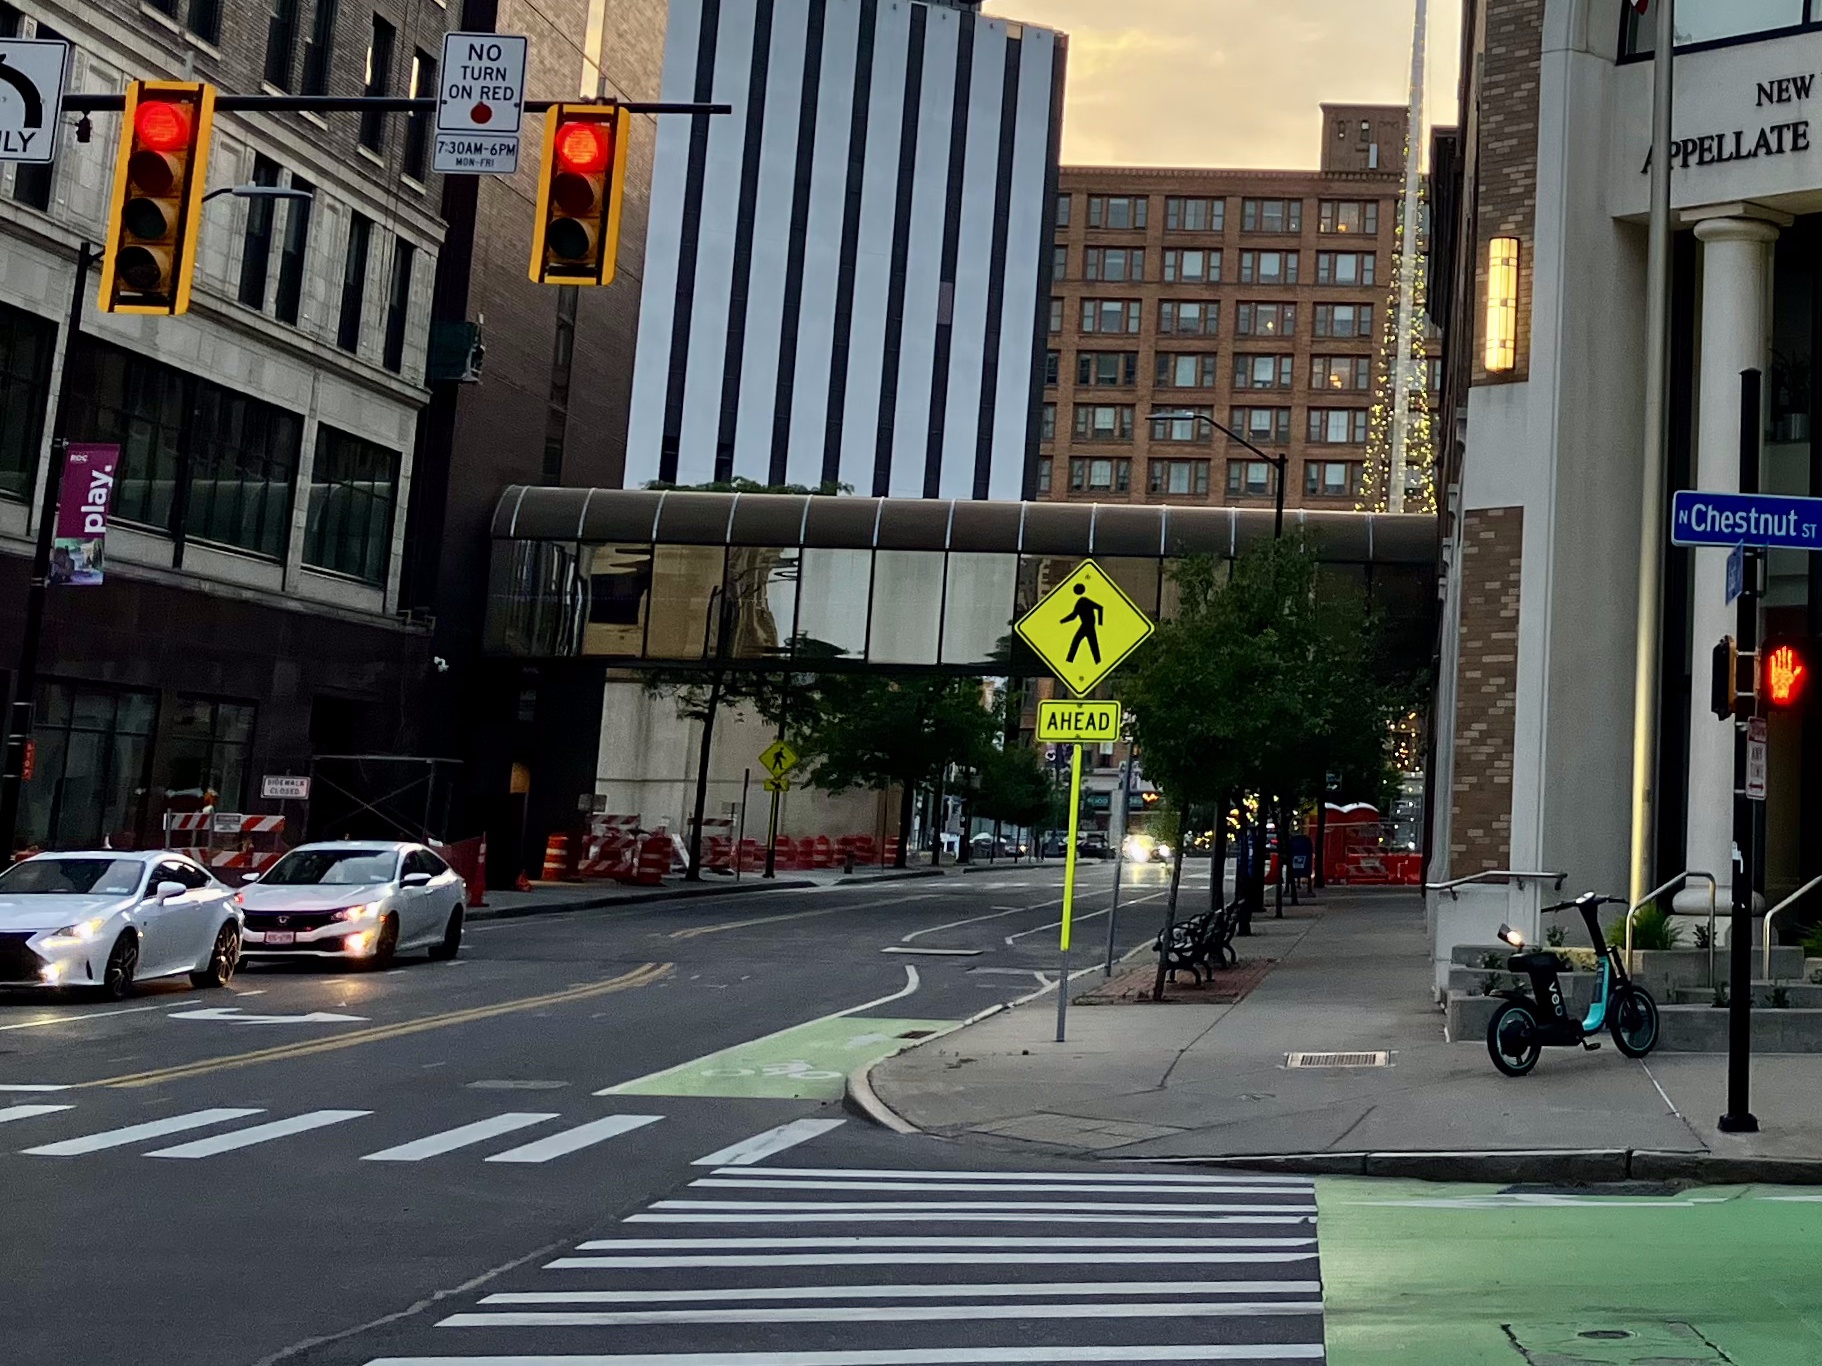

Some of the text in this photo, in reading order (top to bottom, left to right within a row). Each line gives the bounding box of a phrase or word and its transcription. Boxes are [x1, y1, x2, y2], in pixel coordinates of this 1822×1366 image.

[468, 43, 502, 62] NO
[460, 65, 507, 82] TURN
[449, 84, 514, 101] ON RED
[1755, 74, 1814, 107] NEW
[438, 141, 516, 156] 7:30AM-6PM
[455, 157, 495, 167] MON-FRI
[81, 464, 114, 533] play.
[1679, 503, 1817, 539] N Chestnut ST
[1047, 711, 1110, 731] AHEAD
[267, 778, 305, 787] SIDEWALK
[269, 787, 300, 795] CLOSED
